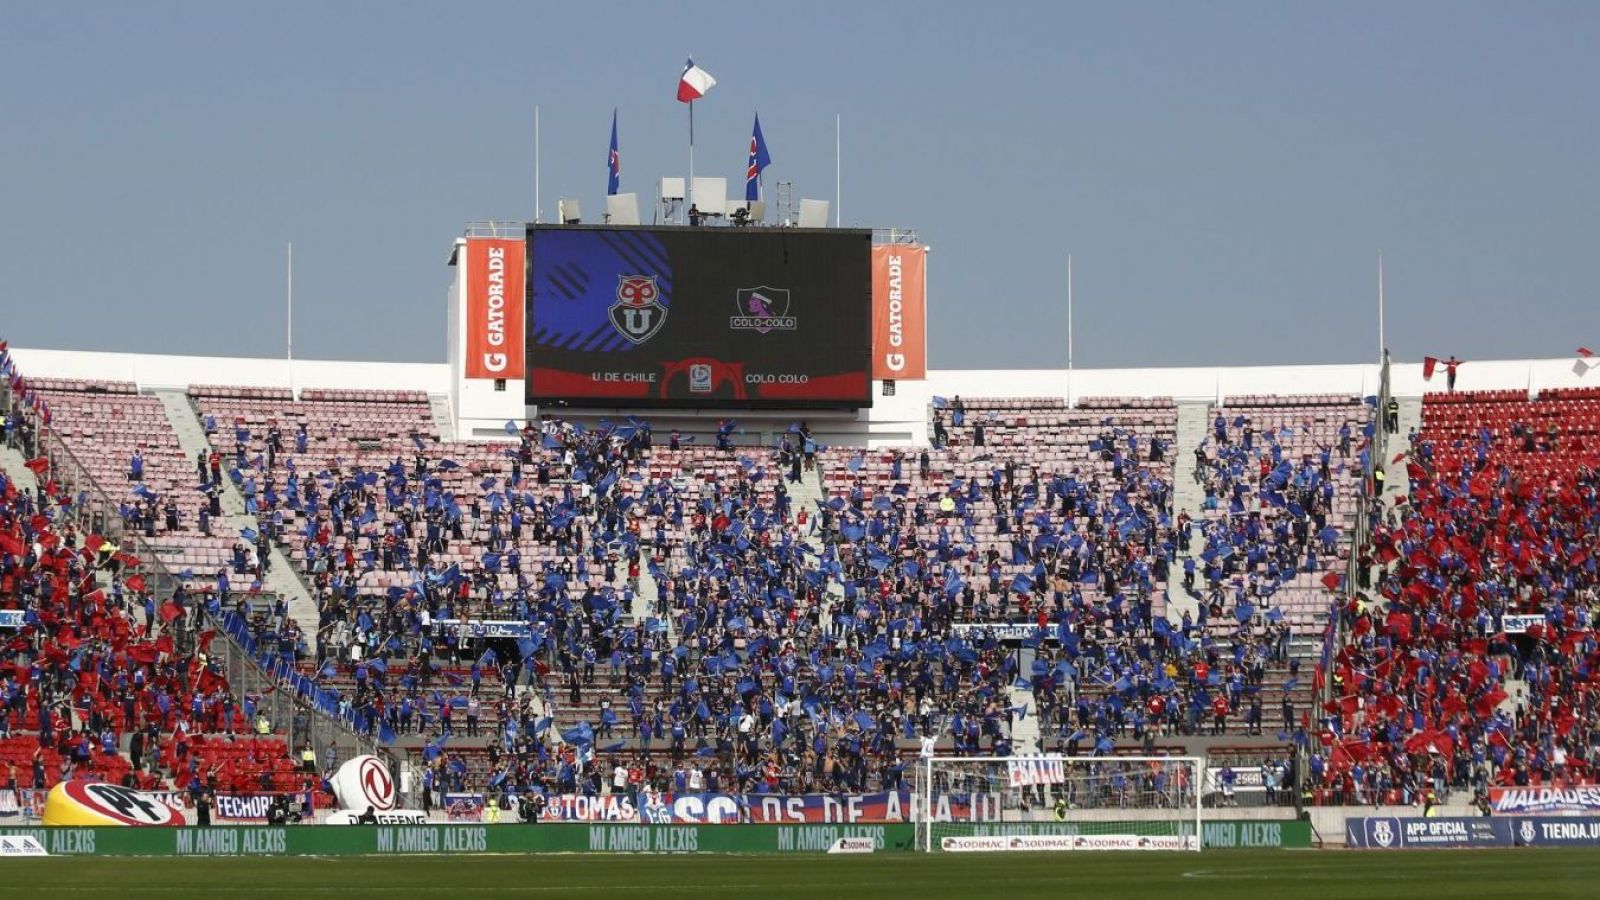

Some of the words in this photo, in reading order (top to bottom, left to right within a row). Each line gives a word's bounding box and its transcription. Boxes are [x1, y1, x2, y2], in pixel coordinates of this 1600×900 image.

[487, 247, 504, 347] GATORADE
[889, 255, 902, 347] GATORADE
[623, 309, 653, 334] U
[733, 318, 794, 327] COLO-COLO
[484, 352, 507, 372] G
[886, 353, 905, 371] G
[592, 372, 600, 382] U
[604, 372, 620, 382] DE
[623, 372, 656, 382] CHILE
[745, 374, 776, 384] COLO
[778, 374, 808, 384] COLO
[562, 794, 634, 819] TOMAS
[377, 827, 393, 851] MI
[396, 827, 438, 851] AMIGO
[444, 827, 487, 851] ALEXIS
[589, 826, 605, 850] MI
[608, 826, 650, 850] AMIGO
[655, 826, 697, 850] ALEXIS
[777, 826, 793, 850] MI
[795, 826, 838, 850] AMIGO
[1241, 823, 1281, 847] ALEXIS
[1407, 822, 1427, 836] APP
[1429, 821, 1468, 835] OFICIAL
[52, 829, 96, 852] ALEXIS
[176, 829, 193, 853] MI
[195, 829, 238, 853] AMIGO
[243, 829, 286, 852] ALEXIS
[958, 840, 1002, 848] SODIMAC
[1024, 839, 1070, 847] SODIMAC
[1088, 839, 1132, 847] SODIMAC
